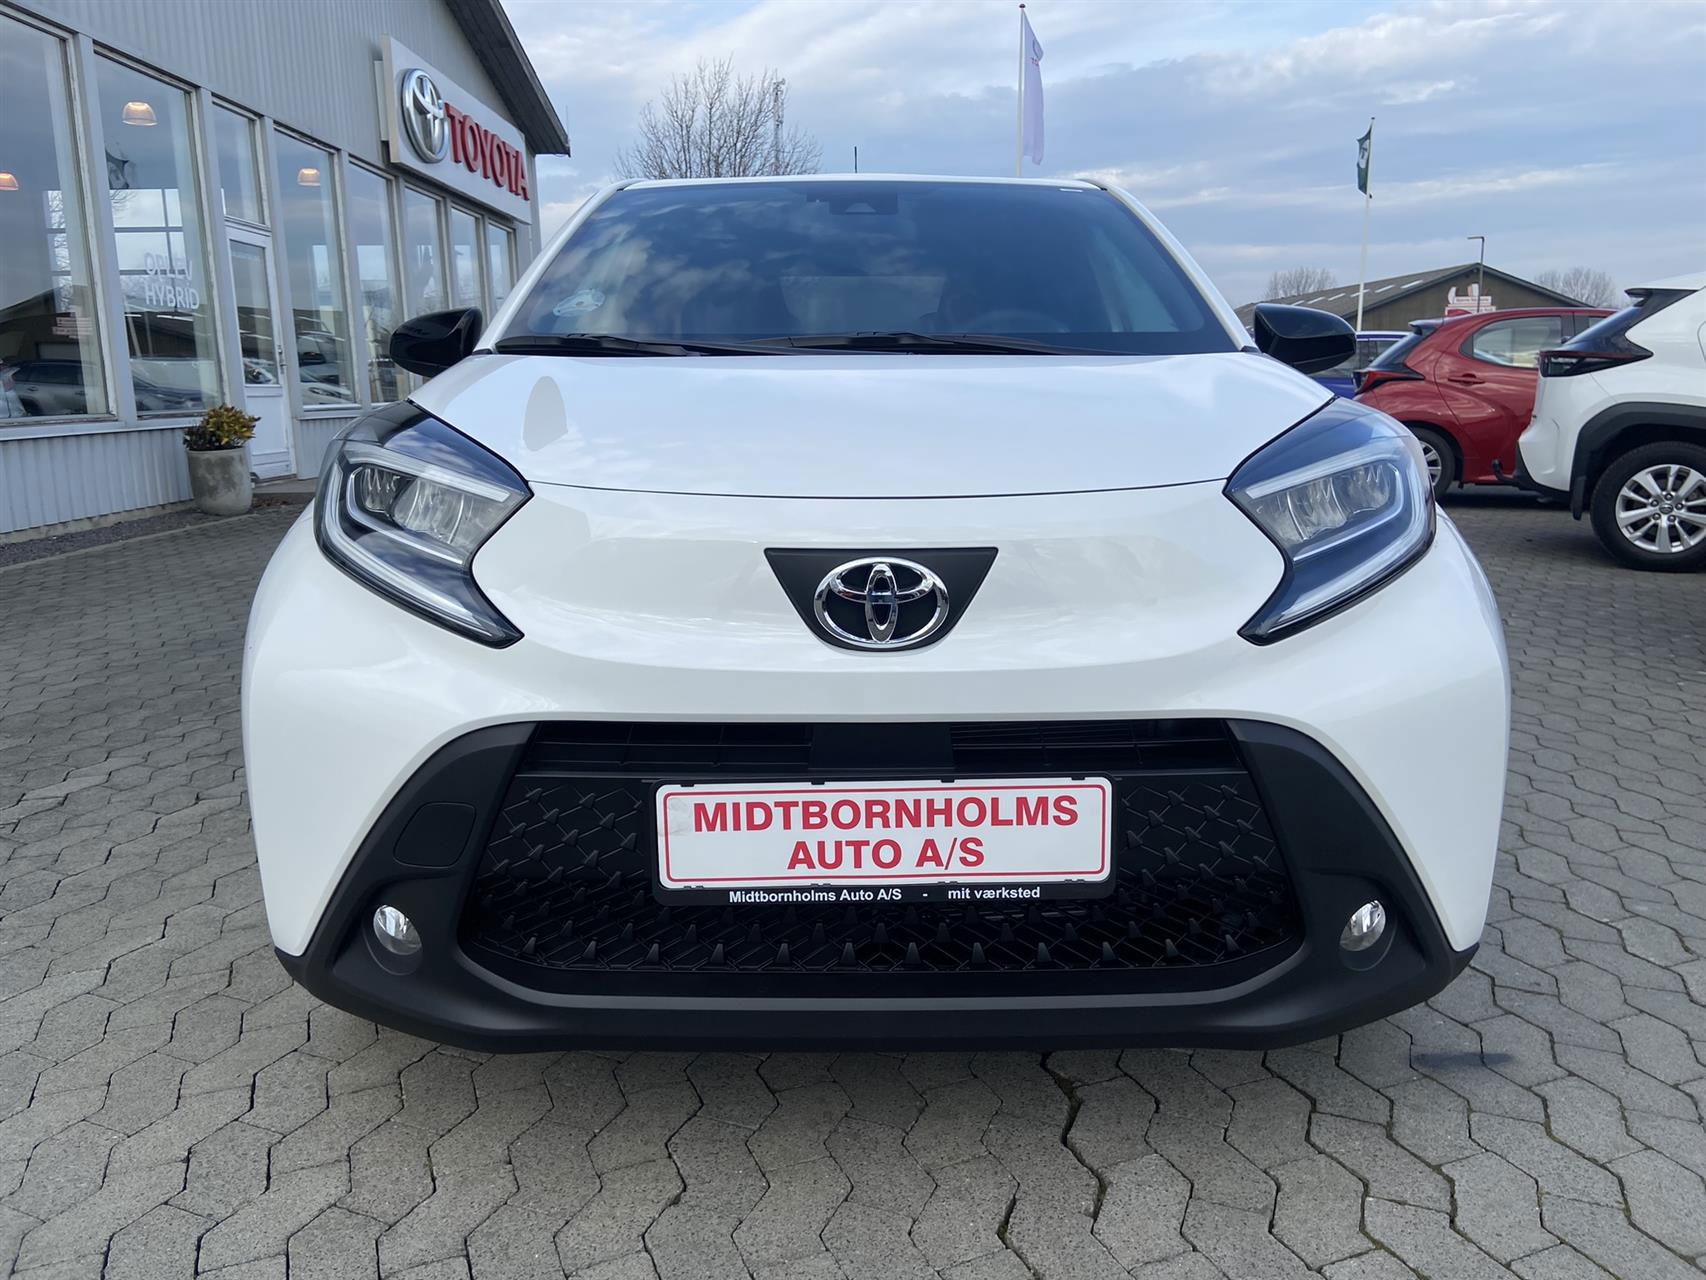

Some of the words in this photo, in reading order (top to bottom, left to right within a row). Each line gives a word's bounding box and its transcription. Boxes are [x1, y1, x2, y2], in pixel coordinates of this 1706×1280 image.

[444, 102, 529, 201] TOYOTA
[145, 281, 200, 309] HYBRID
[694, 795, 1079, 832] MIDTBORNHOLMS
[787, 839, 902, 870] AUTO
[915, 837, 985, 870] A/S
[729, 890, 836, 903] Midtbornholms
[840, 889, 874, 901] Auto
[877, 888, 902, 901] A/S
[948, 888, 971, 899] mit
[974, 886, 1041, 899] værksted
